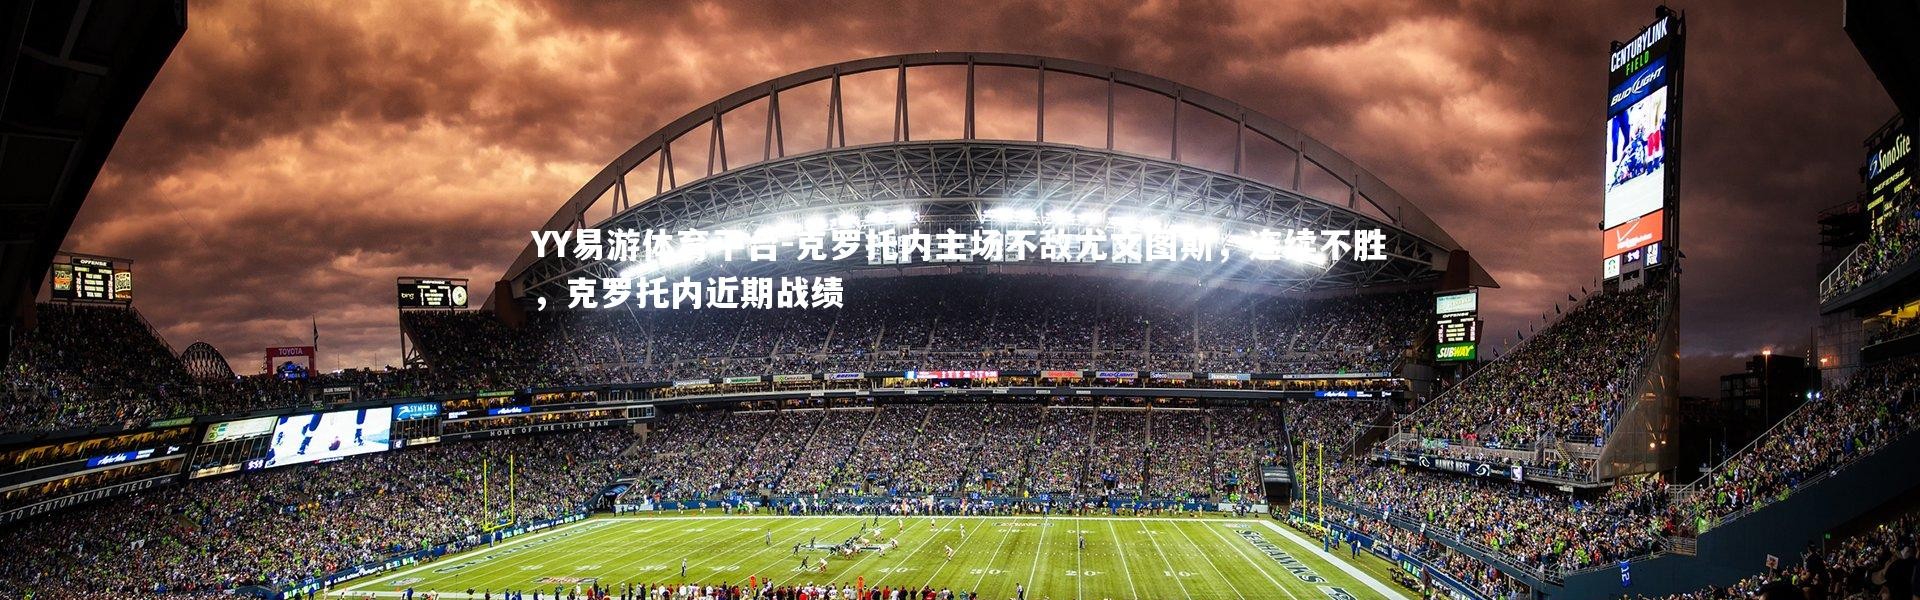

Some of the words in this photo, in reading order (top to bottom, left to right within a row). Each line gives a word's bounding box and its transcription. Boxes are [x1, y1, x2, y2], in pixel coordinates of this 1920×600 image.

[1611, 16, 1668, 72] CENTURYLINK
[1626, 50, 1649, 76] FIELD
[1610, 86, 1632, 107] BUD
[1632, 66, 1664, 93] LIGHT
[1878, 133, 1911, 174] SonoSite
[1873, 167, 1905, 194] DEFENSE
[1437, 345, 1474, 358] SUBWAY
[410, 404, 438, 412] SYMETRA
[490, 428, 516, 436] HOME
[1455, 461, 1470, 472] NEST
[9, 509, 23, 523] TO
[30, 489, 112, 516] CENTURYLINK
[118, 481, 153, 494] FIELD
[1233, 529, 1329, 583] SEAHAWKS
